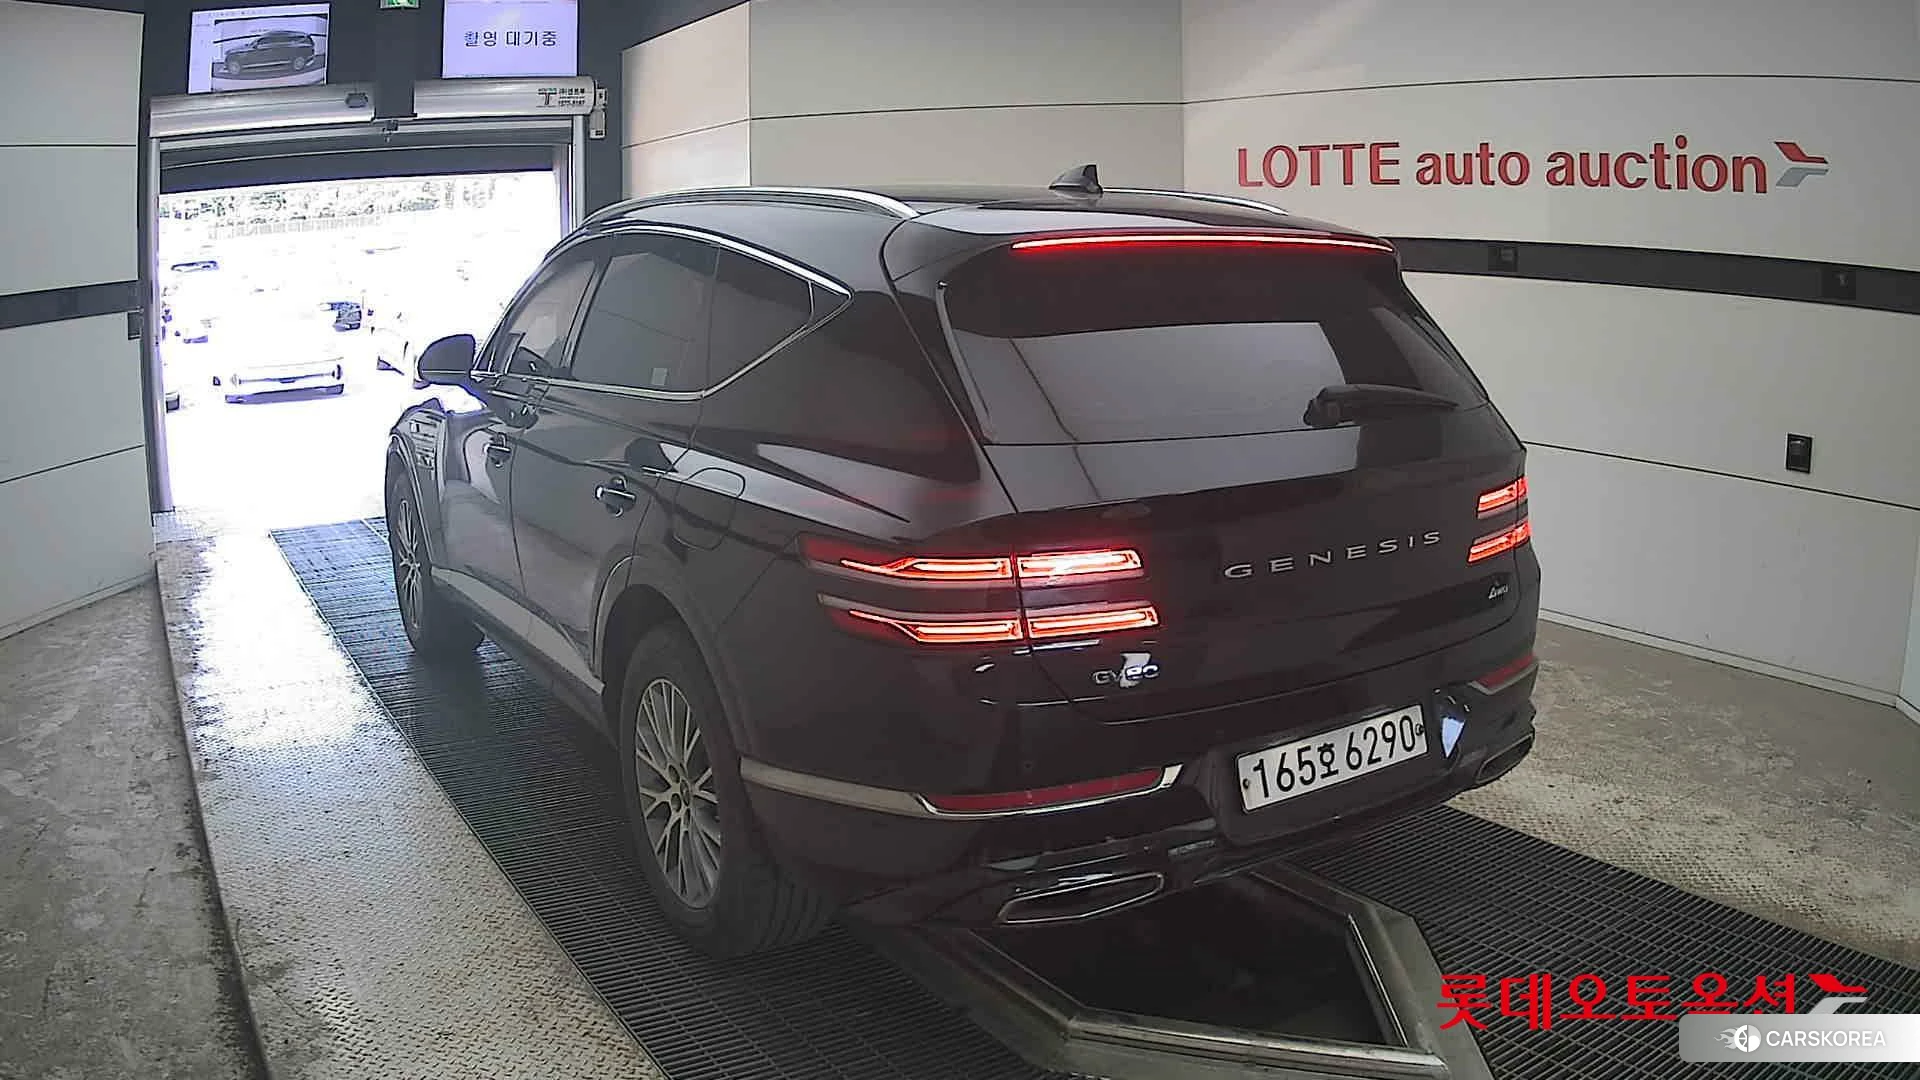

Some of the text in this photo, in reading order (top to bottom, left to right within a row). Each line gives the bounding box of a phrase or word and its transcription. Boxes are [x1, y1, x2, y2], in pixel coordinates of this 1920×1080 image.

[506, 31, 557, 47] 대기중
[1238, 135, 1767, 193] LOTTE auto auction
[1224, 531, 1440, 578] GENESIS
[1346, 715, 1416, 771] 6290
